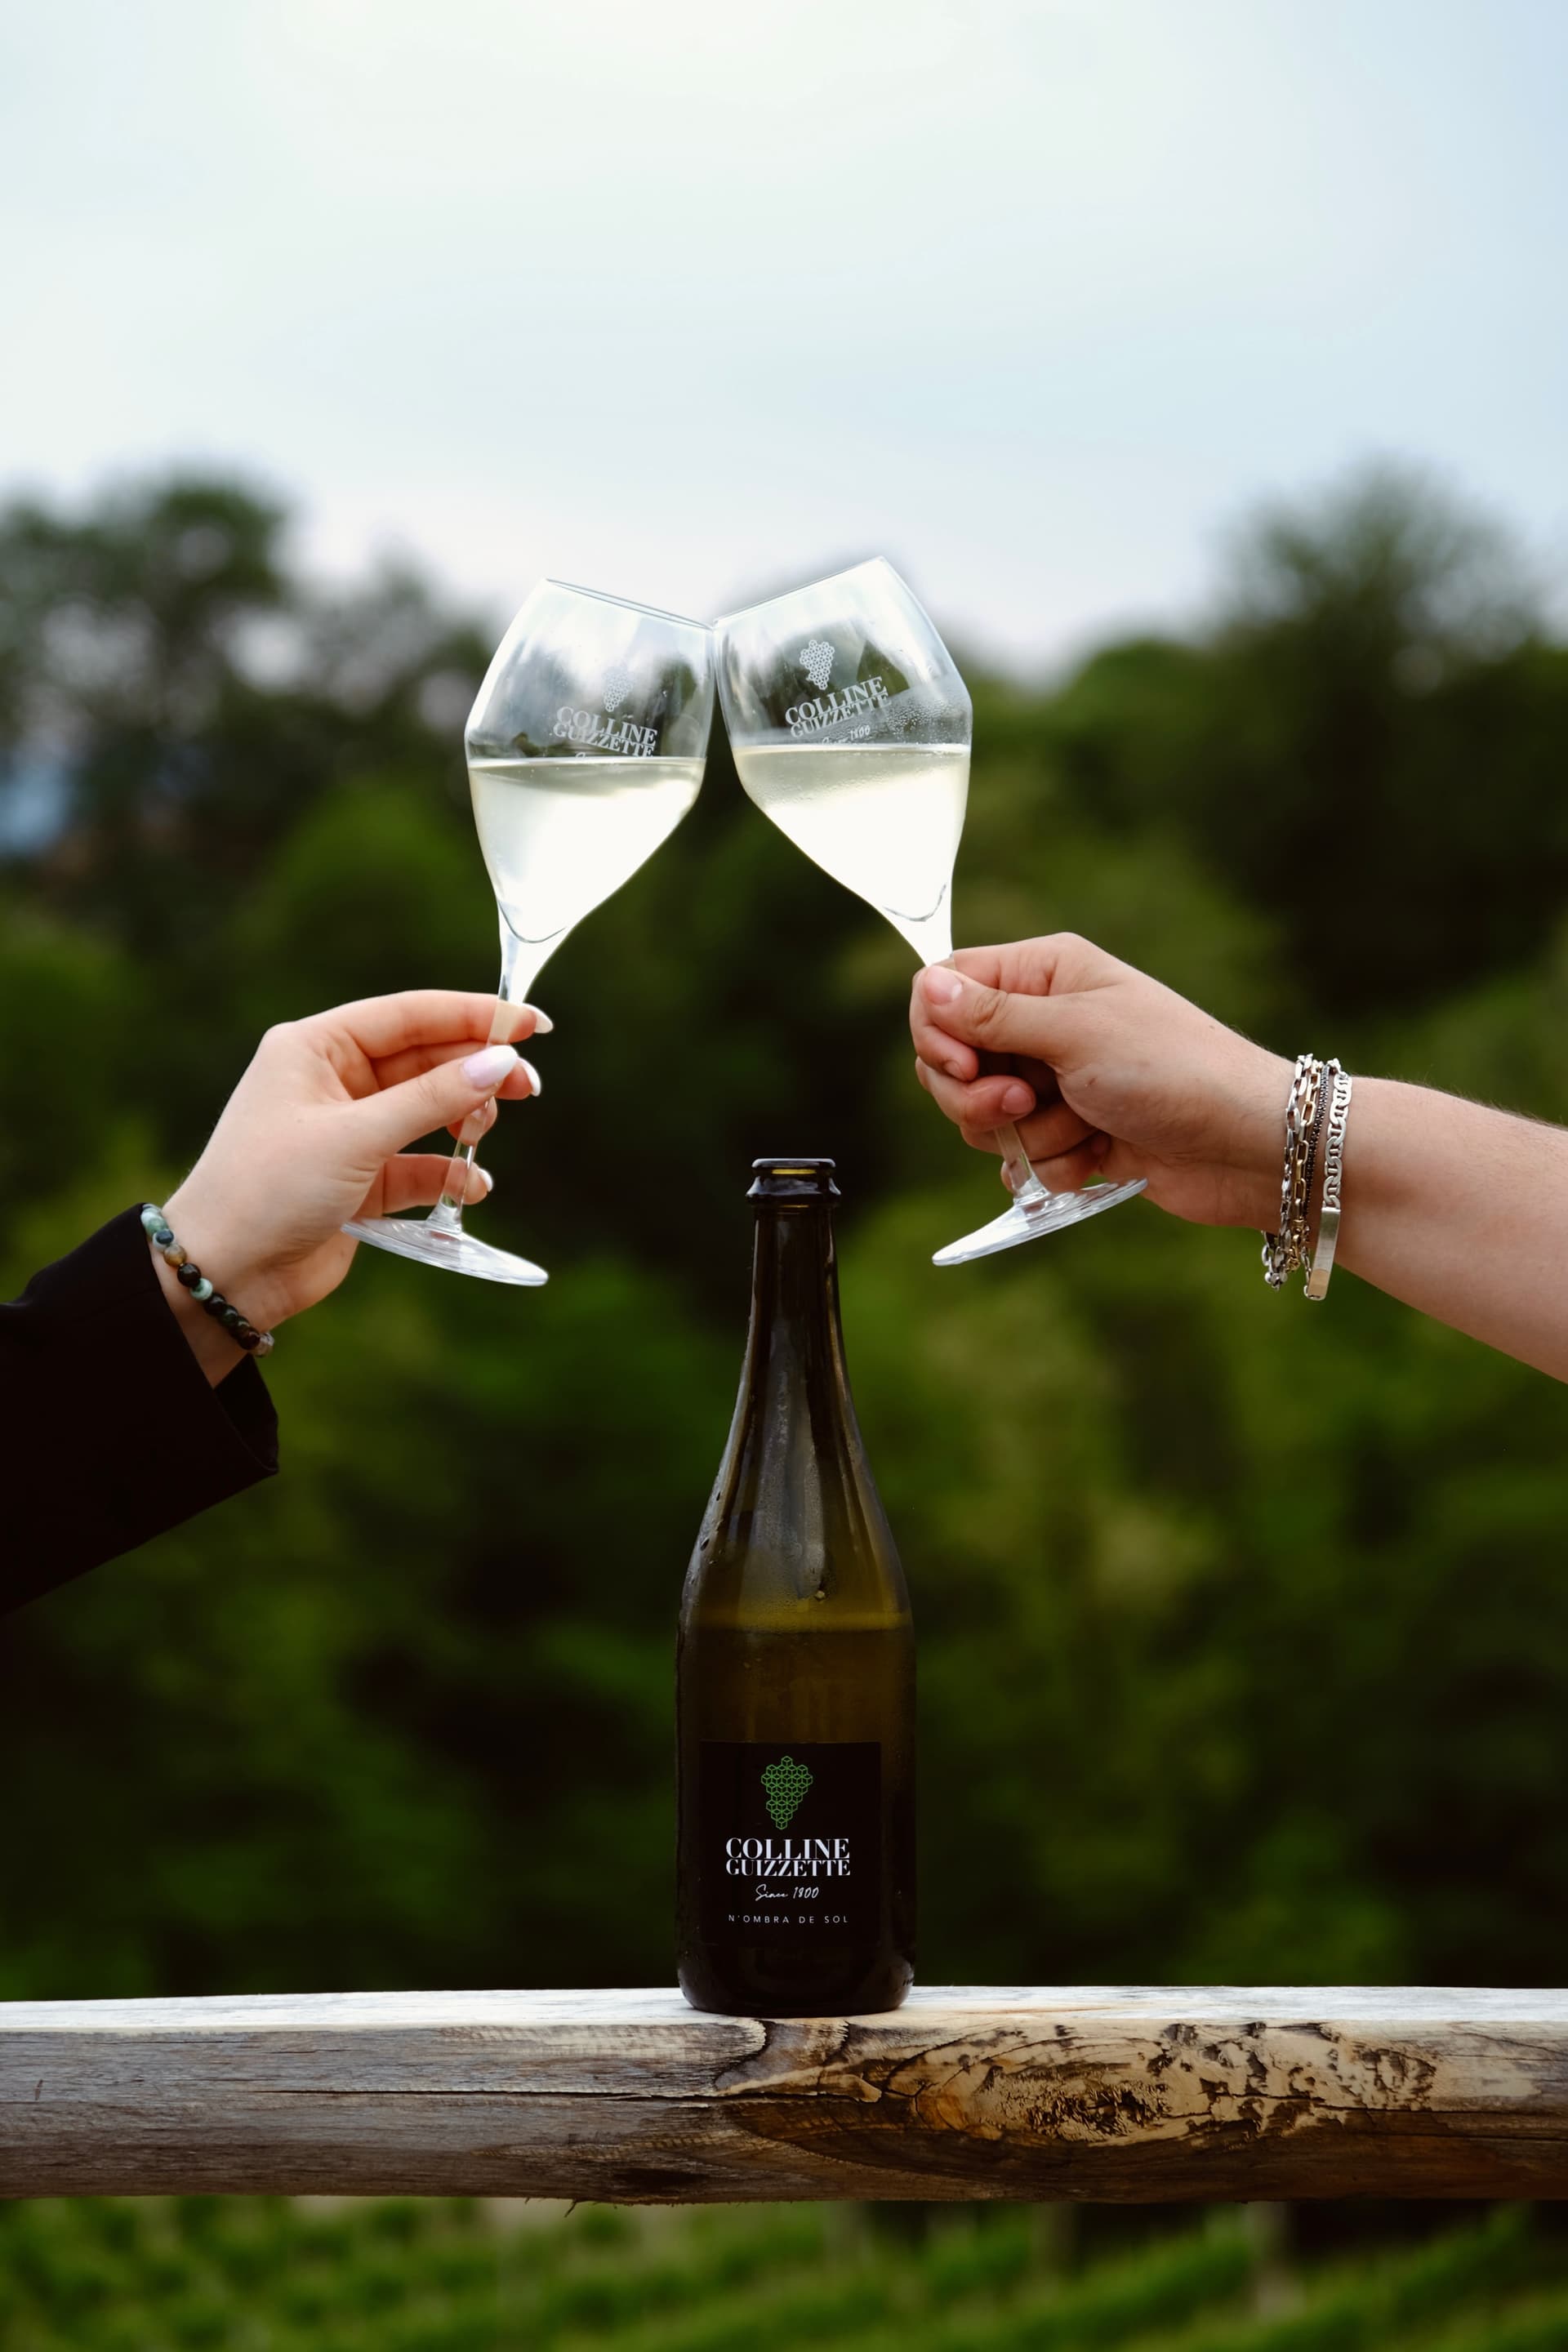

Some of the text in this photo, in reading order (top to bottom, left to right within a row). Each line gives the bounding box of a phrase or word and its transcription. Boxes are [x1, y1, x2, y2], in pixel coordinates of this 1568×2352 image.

[785, 676, 888, 725] COLLINE
[790, 691, 892, 738] GUIZZETTE
[553, 722, 654, 758] GUIZZETTE
[556, 706, 657, 746] COLLINE
[725, 1838, 850, 1859] COLLINE
[725, 1859, 851, 1877] GUIZZETTE
[755, 1883, 820, 1901] Since 1800
[728, 1914, 849, 1924] N'OMBRA DE SOL
